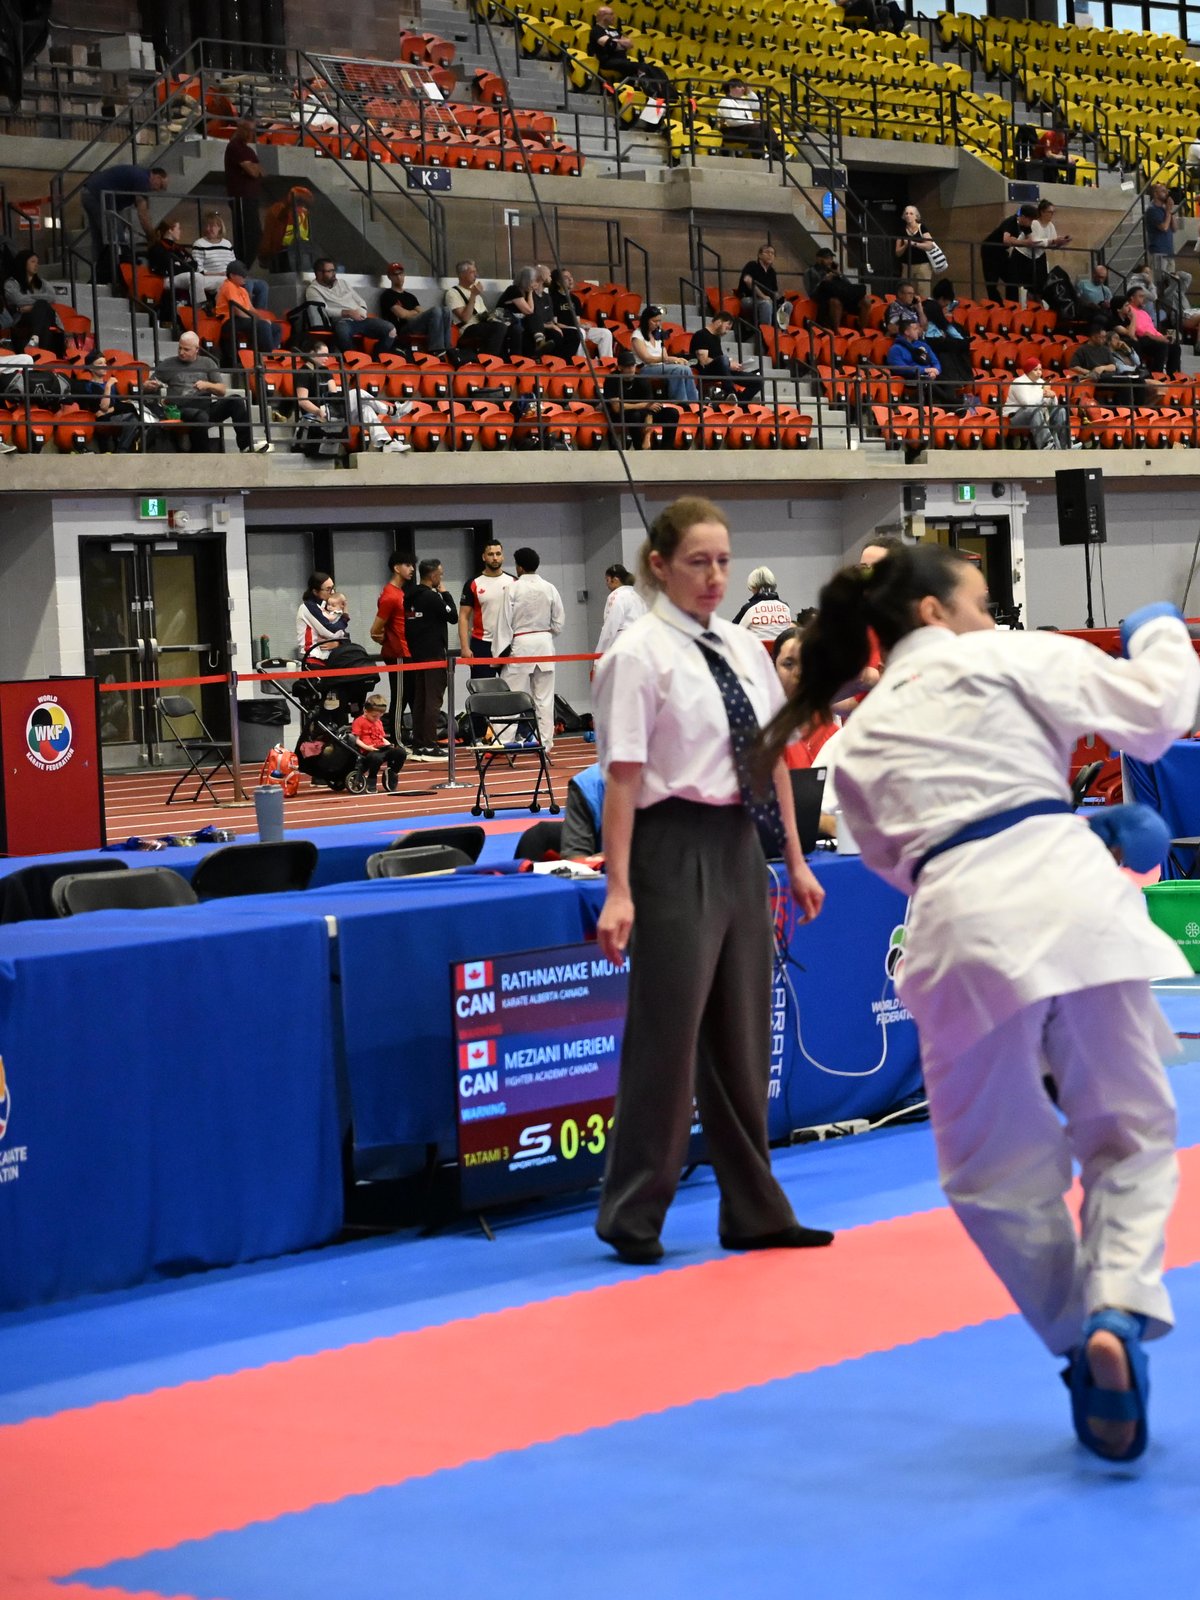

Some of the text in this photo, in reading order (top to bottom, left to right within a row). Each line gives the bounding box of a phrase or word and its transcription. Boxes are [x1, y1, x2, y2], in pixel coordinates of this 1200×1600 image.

[755, 604, 788, 613] LOUISE
[752, 615, 791, 625] COACH
[37, 694, 58, 703] WORLD
[34, 724, 63, 742] WKF
[26, 747, 75, 771] KARATE FEDERATION
[501, 961, 588, 991] RATHNAYAKE
[456, 991, 495, 1018] CAN
[504, 1035, 615, 1070] MEZIANI MERIEM
[459, 1070, 499, 1097] CAN
[464, 1146, 510, 1167] TATAMI 3
